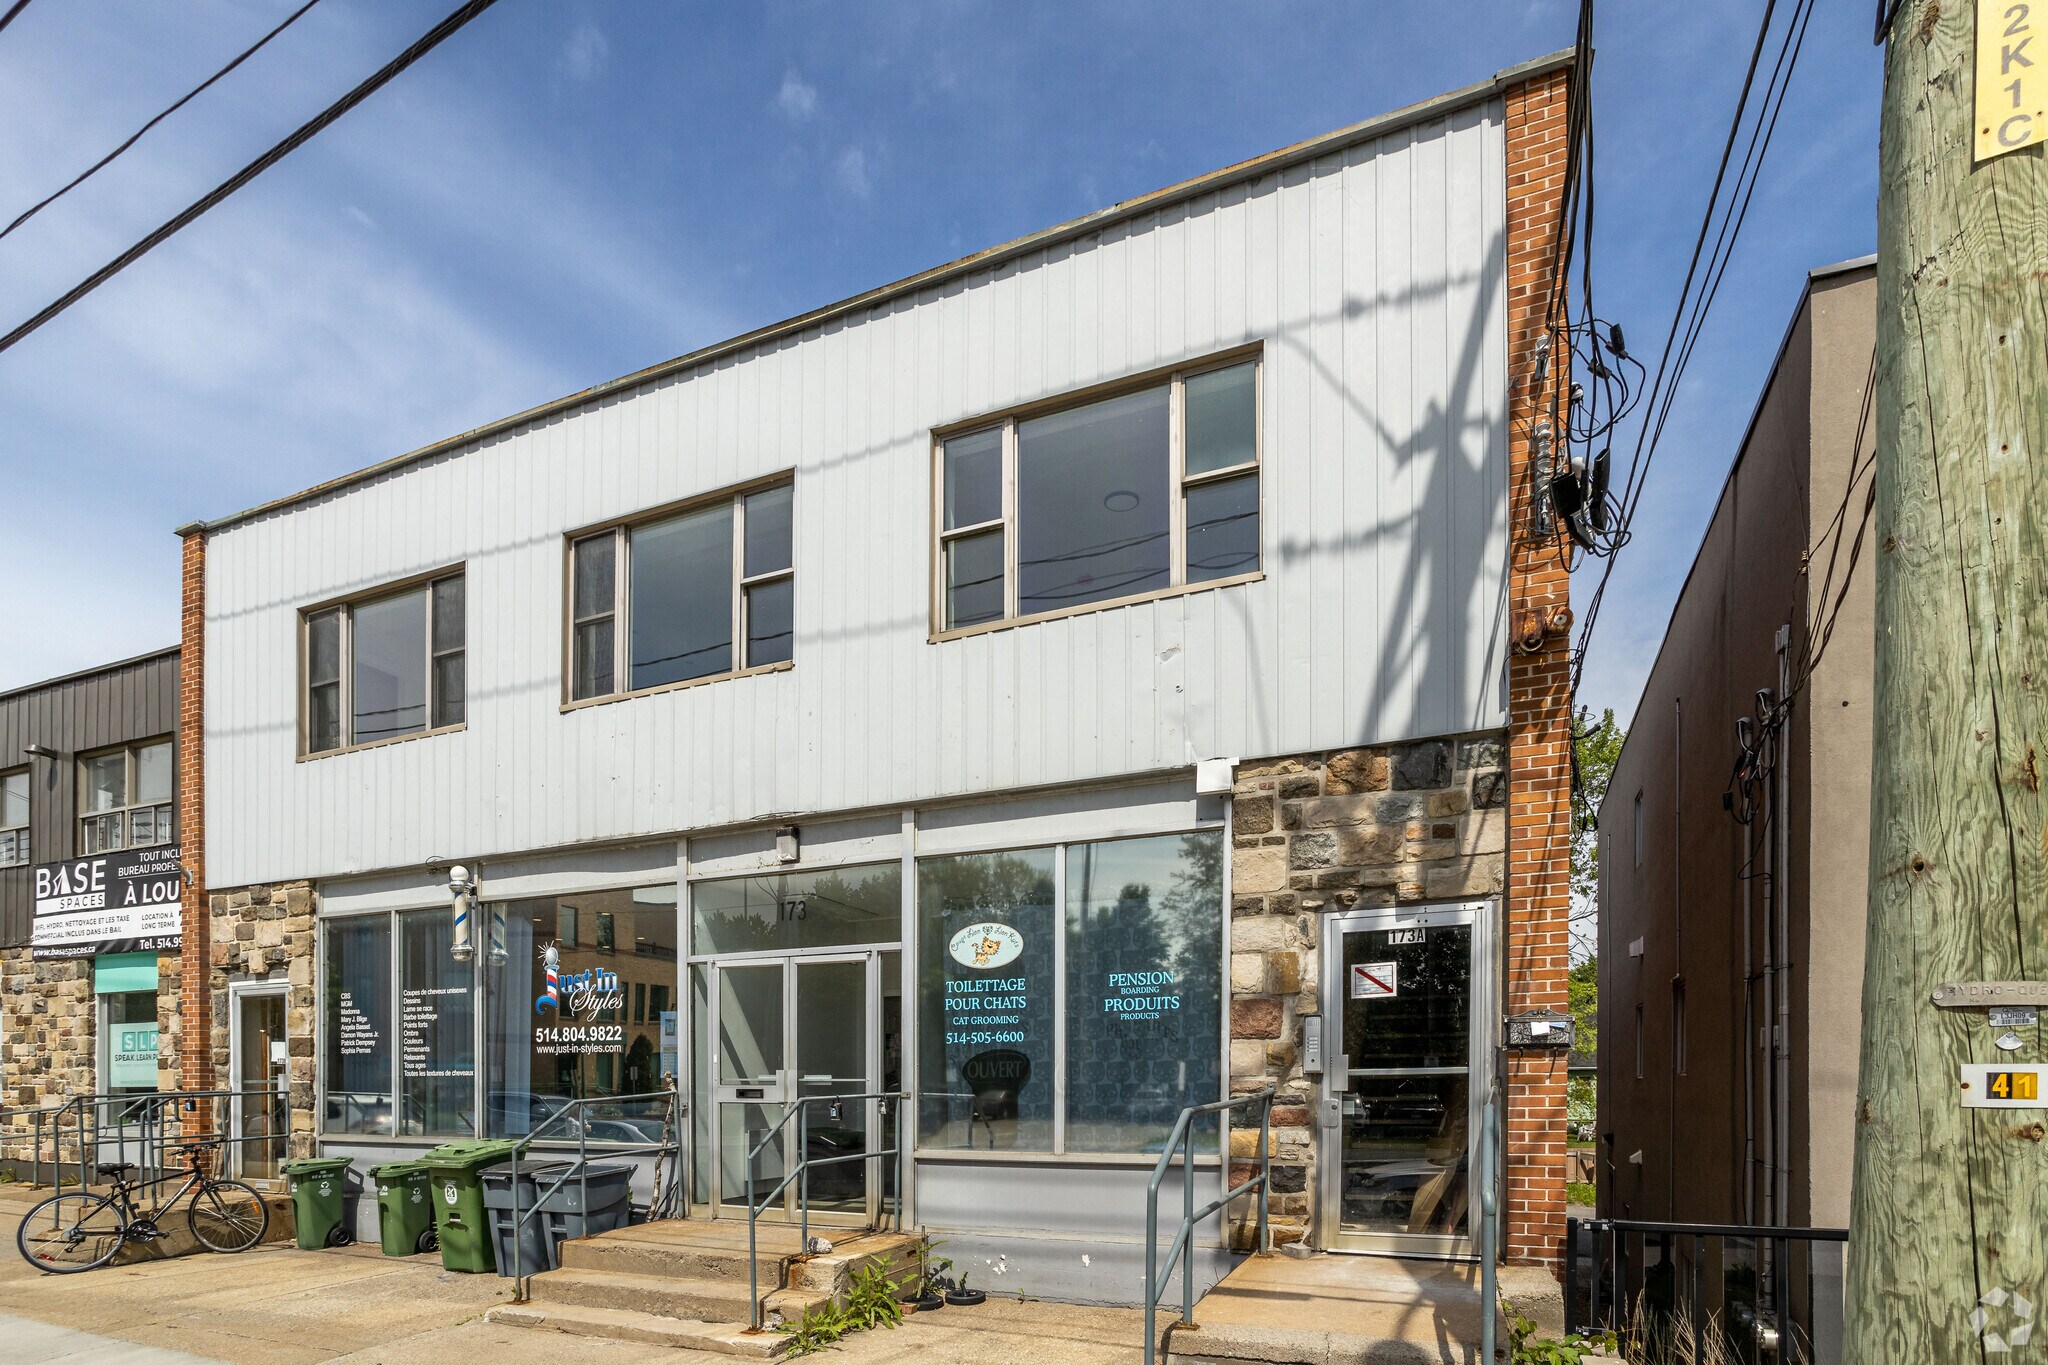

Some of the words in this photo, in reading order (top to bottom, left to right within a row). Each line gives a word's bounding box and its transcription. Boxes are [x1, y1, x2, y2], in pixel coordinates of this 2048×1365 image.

[138, 851, 161, 862] TOUT
[118, 864, 150, 877] BUREAU
[151, 861, 180, 873] PROFE
[36, 859, 106, 899] BASE
[124, 880, 137, 905] À
[142, 880, 180, 903] LOU
[60, 895, 104, 909] SPACES
[141, 912, 169, 920] LOCATION
[780, 900, 806, 921] 173
[65, 918, 97, 928] NETTOYAGE
[141, 922, 156, 930] LONG
[158, 920, 175, 928] TERME
[65, 930, 85, 938] INCLUS
[86, 928, 102, 936] DANS
[1390, 928, 1424, 943] 173A
[140, 939, 155, 949] Tel.
[595, 967, 618, 992] In
[945, 978, 1026, 993] TOILETTAGE
[1109, 971, 1174, 987] PENSION
[1120, 986, 1160, 995] BOARDING
[569, 984, 624, 1022] Styles
[945, 997, 980, 1010] POUR
[983, 996, 1027, 1010] CHATS
[1104, 996, 1180, 1012] PRODUITS
[953, 1016, 969, 1025] CAT
[970, 1015, 1019, 1025] GROOMING
[1120, 1012, 1160, 1021] PRODUCTS
[536, 1026, 622, 1042] 514.804.9822
[945, 1031, 1024, 1045] 514-505-6600
[536, 1043, 622, 1056] www.just-in-styles.com
[967, 1060, 1022, 1079] OUVERT
